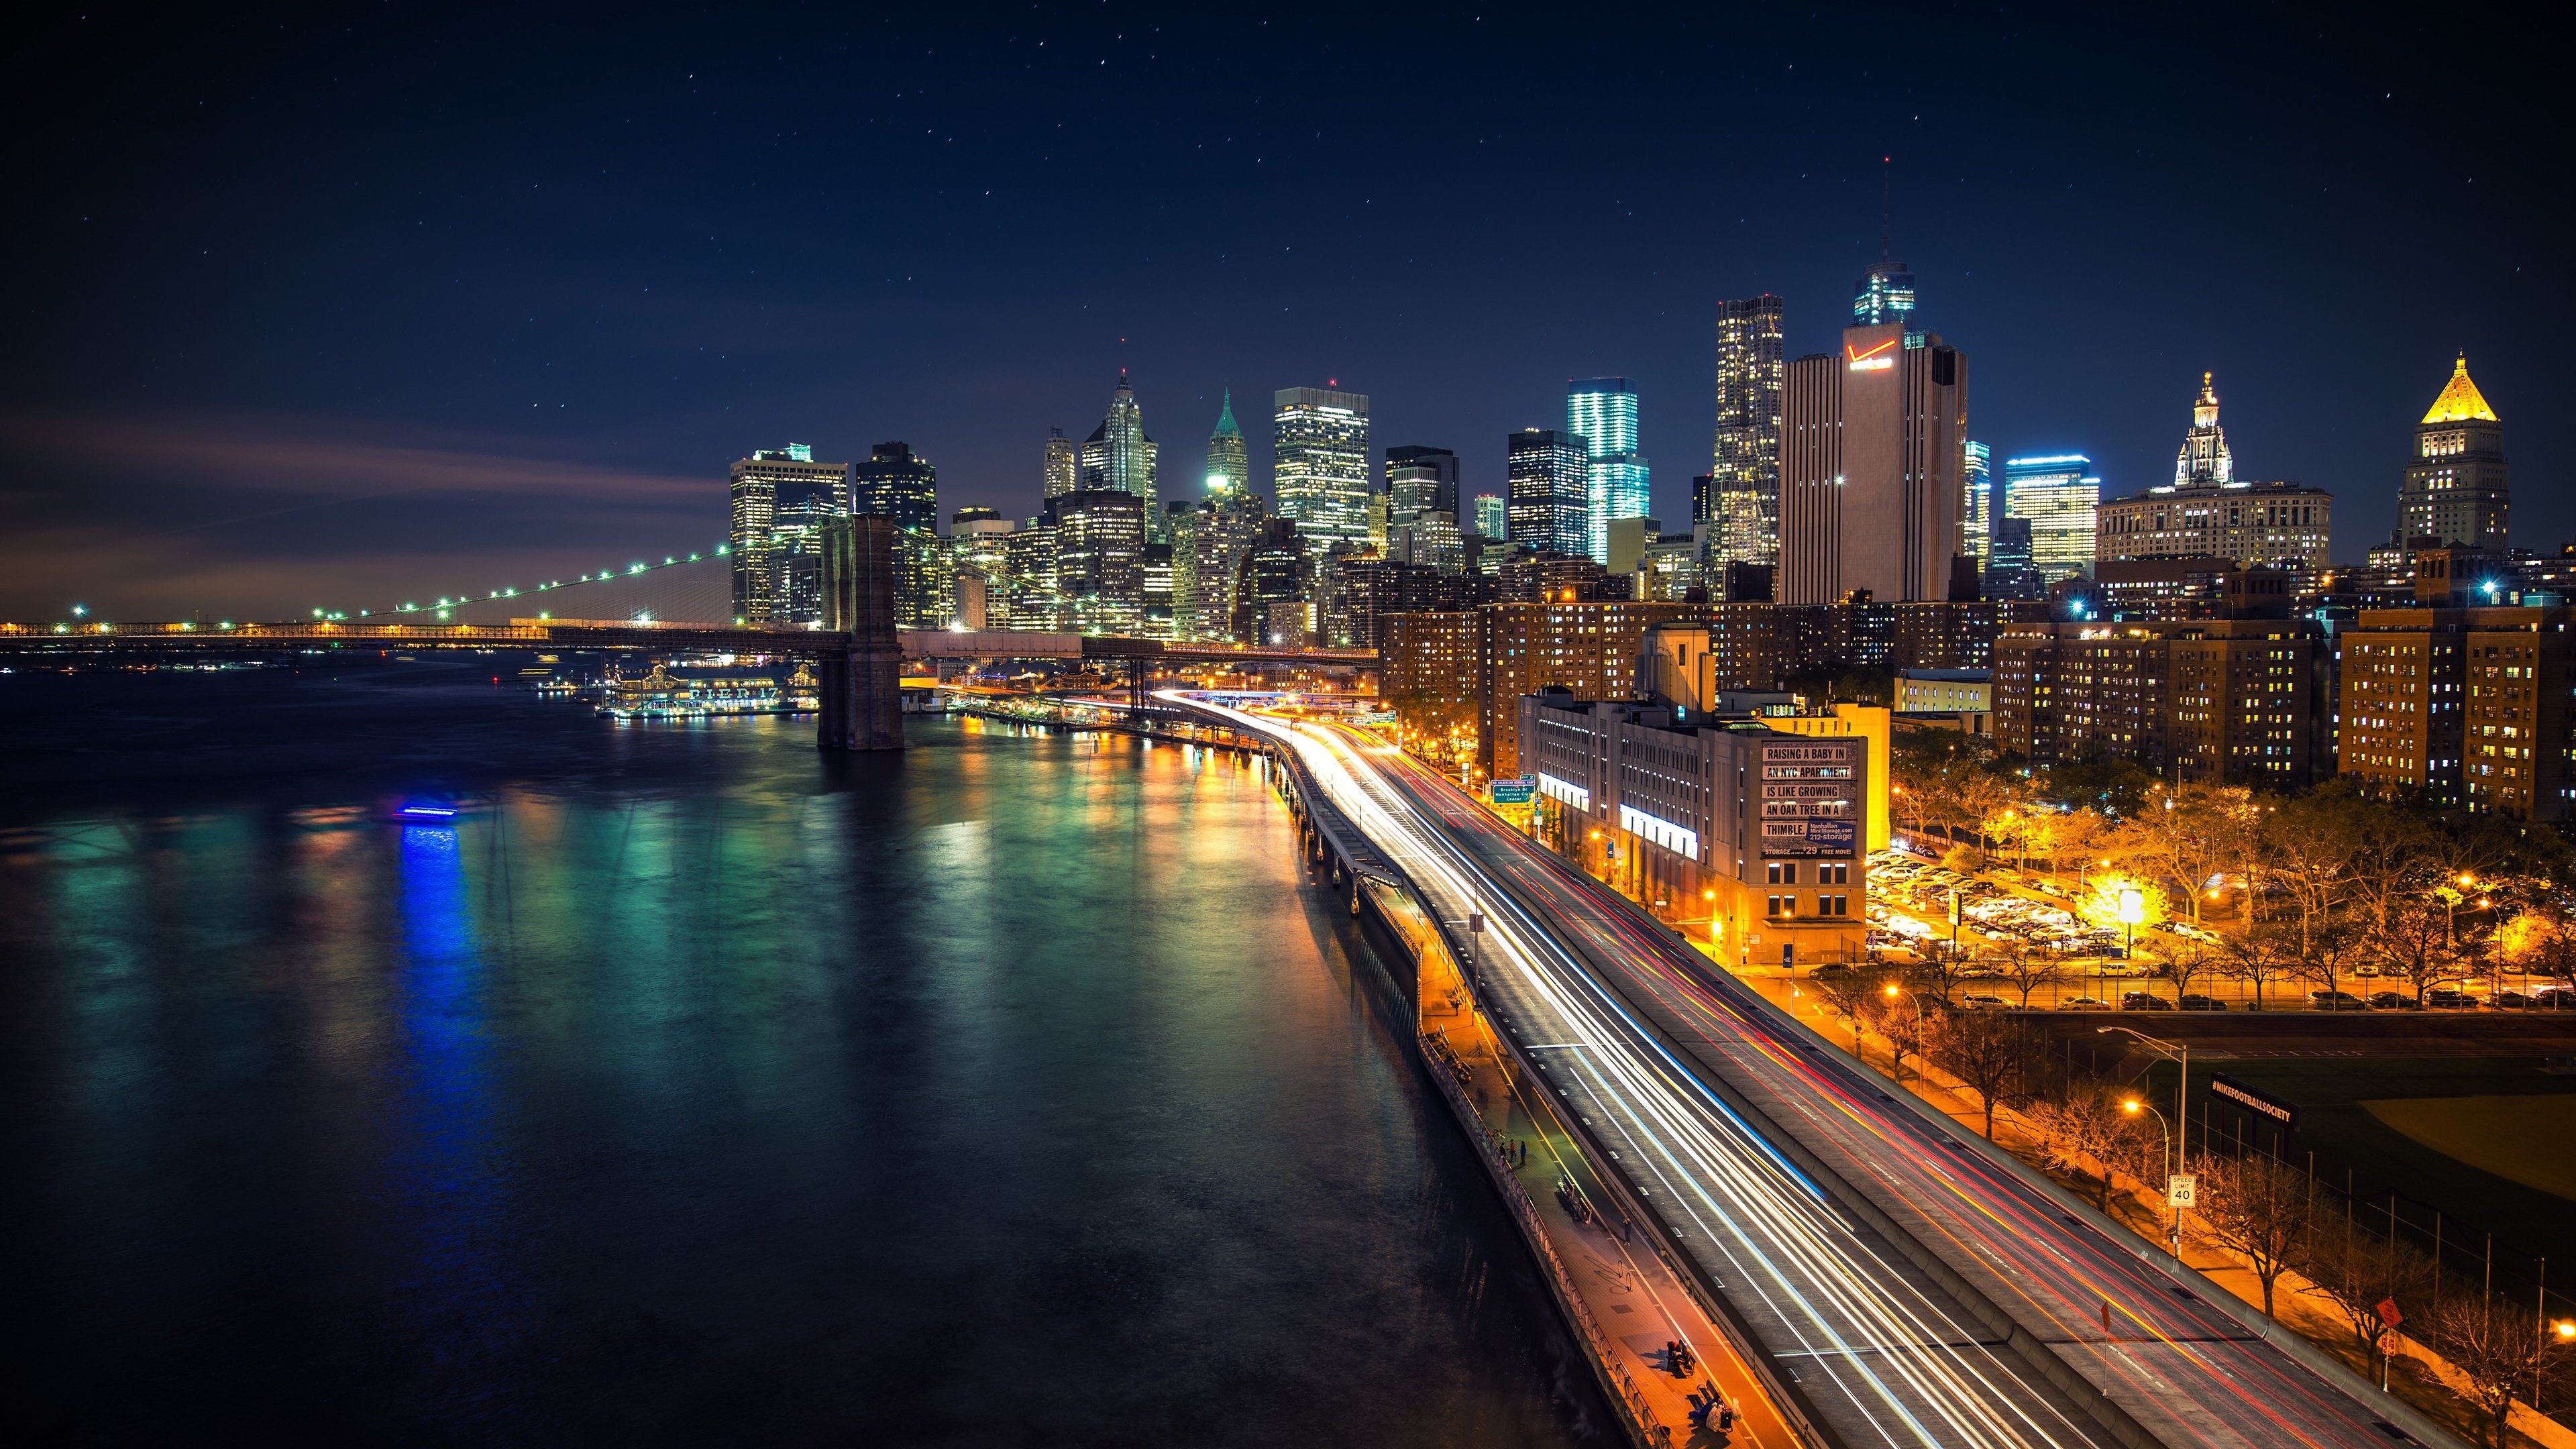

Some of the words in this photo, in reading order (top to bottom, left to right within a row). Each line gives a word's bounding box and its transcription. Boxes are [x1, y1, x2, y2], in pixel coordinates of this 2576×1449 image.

[689, 688, 749, 700] PIER
[760, 688, 778, 698] 17
[1768, 749, 1801, 759] RAISING
[1803, 749, 1809, 759] A
[1811, 749, 1833, 759] BABY
[1836, 749, 1844, 759] IN
[1768, 767, 1778, 777] AN
[1781, 767, 1797, 777] NYC
[1800, 767, 1849, 777] APARTMENT
[1767, 786, 1775, 797] IS
[1778, 786, 1796, 797] LIKE
[1799, 786, 1837, 797] GROWING
[1767, 805, 1778, 815] AN
[1780, 805, 1796, 815] OAK
[1799, 805, 1819, 815] TREE
[1823, 805, 1831, 815] IN
[1833, 805, 1839, 815] A
[1767, 824, 1805, 835] THIMBLE.
[1803, 846, 1817, 855] $29
[2212, 1080, 2291, 1122] #NIKEFOOTBALLSOCIETY
[2175, 1190, 2190, 1199] 40
